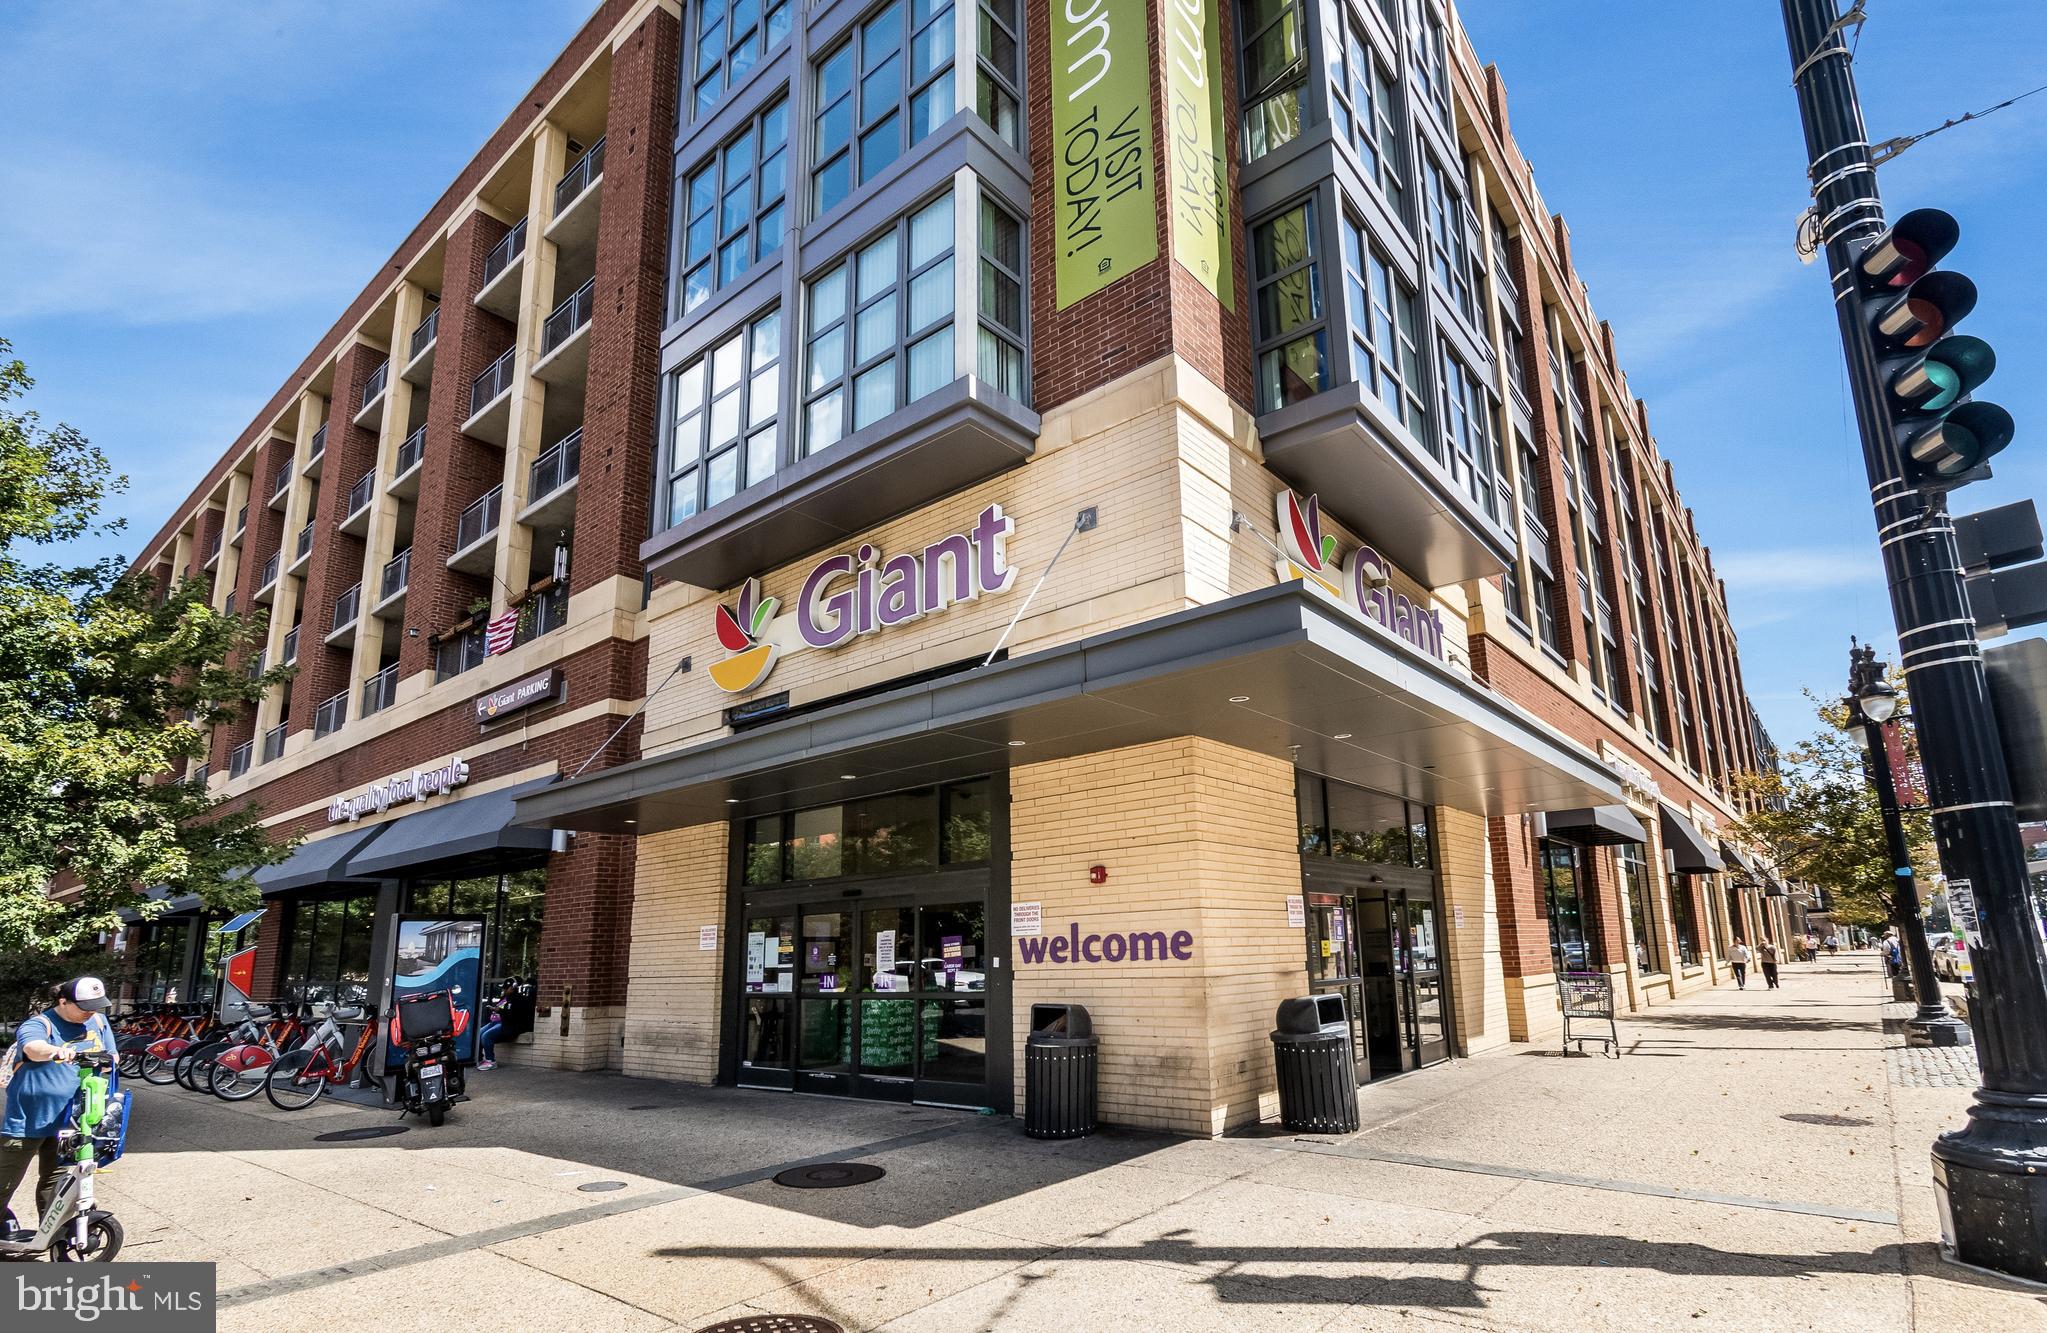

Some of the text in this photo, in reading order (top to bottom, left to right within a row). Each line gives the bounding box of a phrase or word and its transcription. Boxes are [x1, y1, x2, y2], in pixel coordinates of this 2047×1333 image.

[1064, 105, 1103, 258] TODAY!
[1104, 105, 1143, 203] VISIT
[1175, 87, 1204, 237] TODAY!
[1201, 149, 1225, 238] VISIT
[797, 503, 1019, 648] Giant
[1343, 546, 1444, 663] Giant
[498, 678, 549, 708] Giant PARKING
[328, 757, 469, 822] the quality food people
[823, 975, 834, 988] IN
[1018, 922, 1194, 965] welcome
